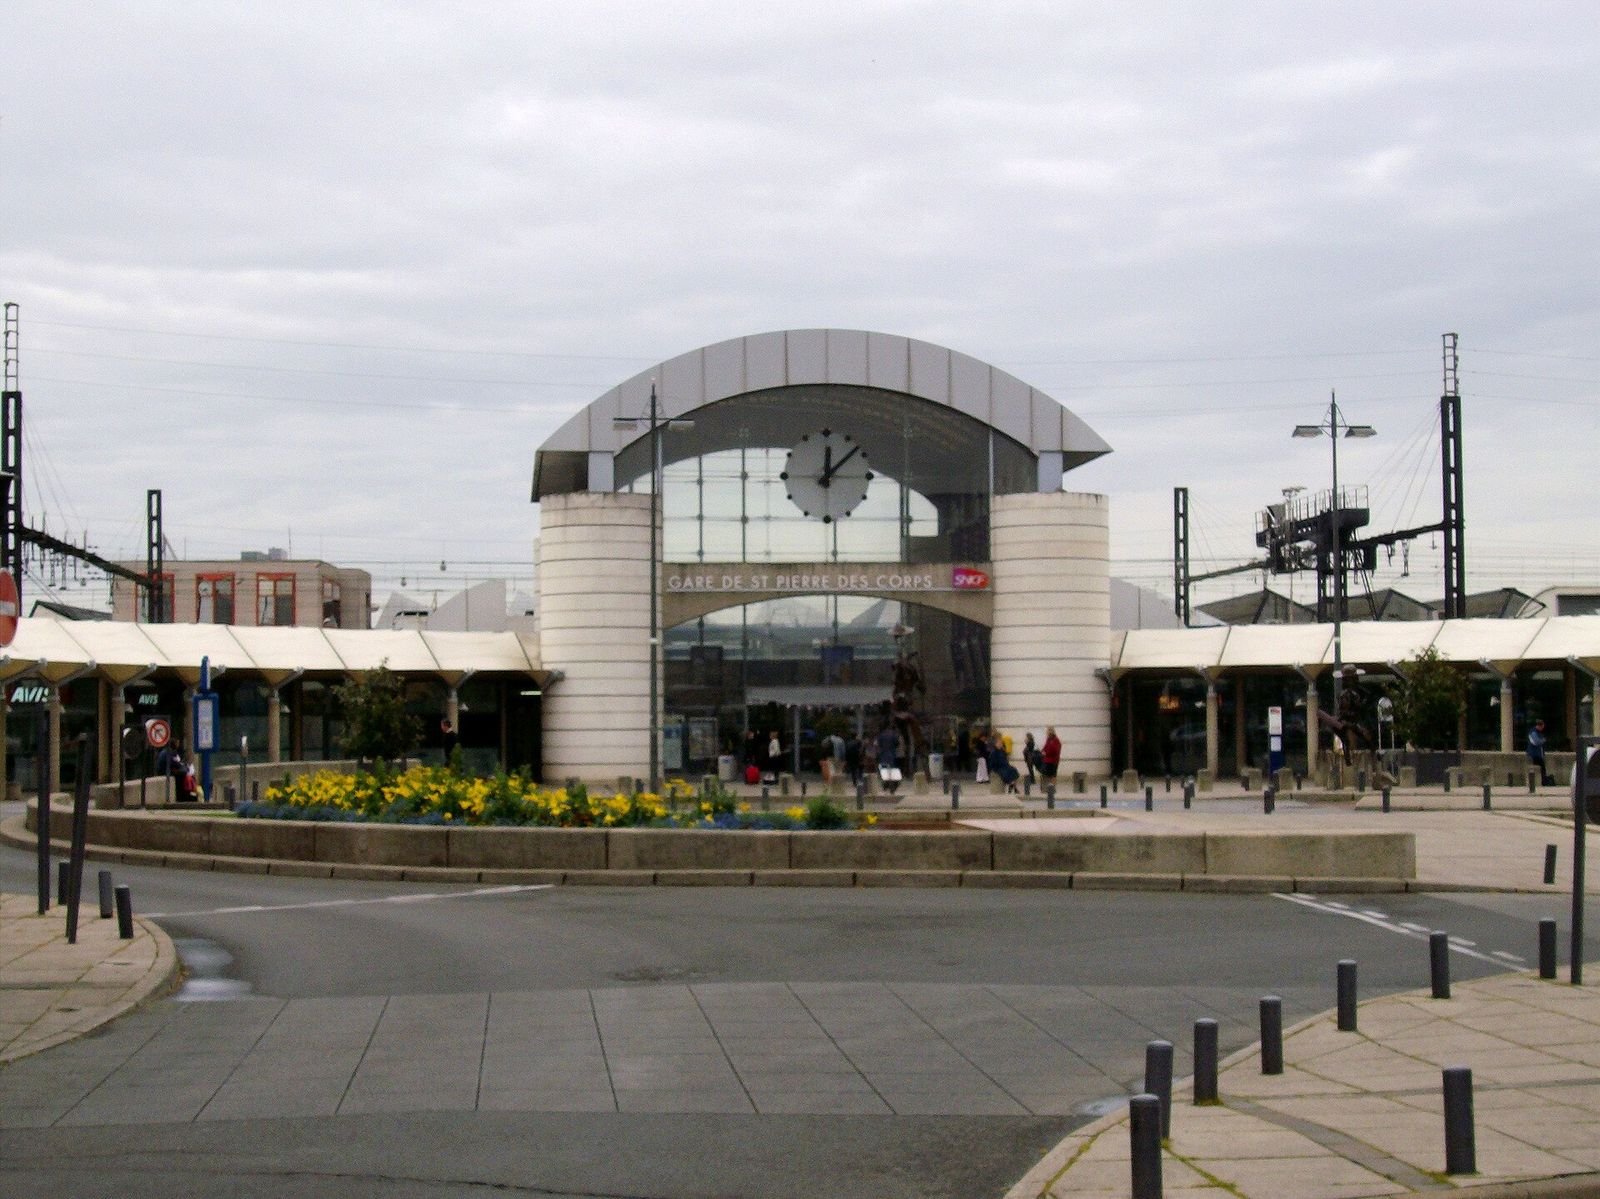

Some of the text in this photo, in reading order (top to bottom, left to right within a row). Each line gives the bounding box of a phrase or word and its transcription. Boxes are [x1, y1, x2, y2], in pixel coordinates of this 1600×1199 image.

[668, 574, 933, 590] GARE DE ST PIERRE DES CORPS
[954, 573, 985, 587] SNCF
[138, 694, 159, 705] AVIS
